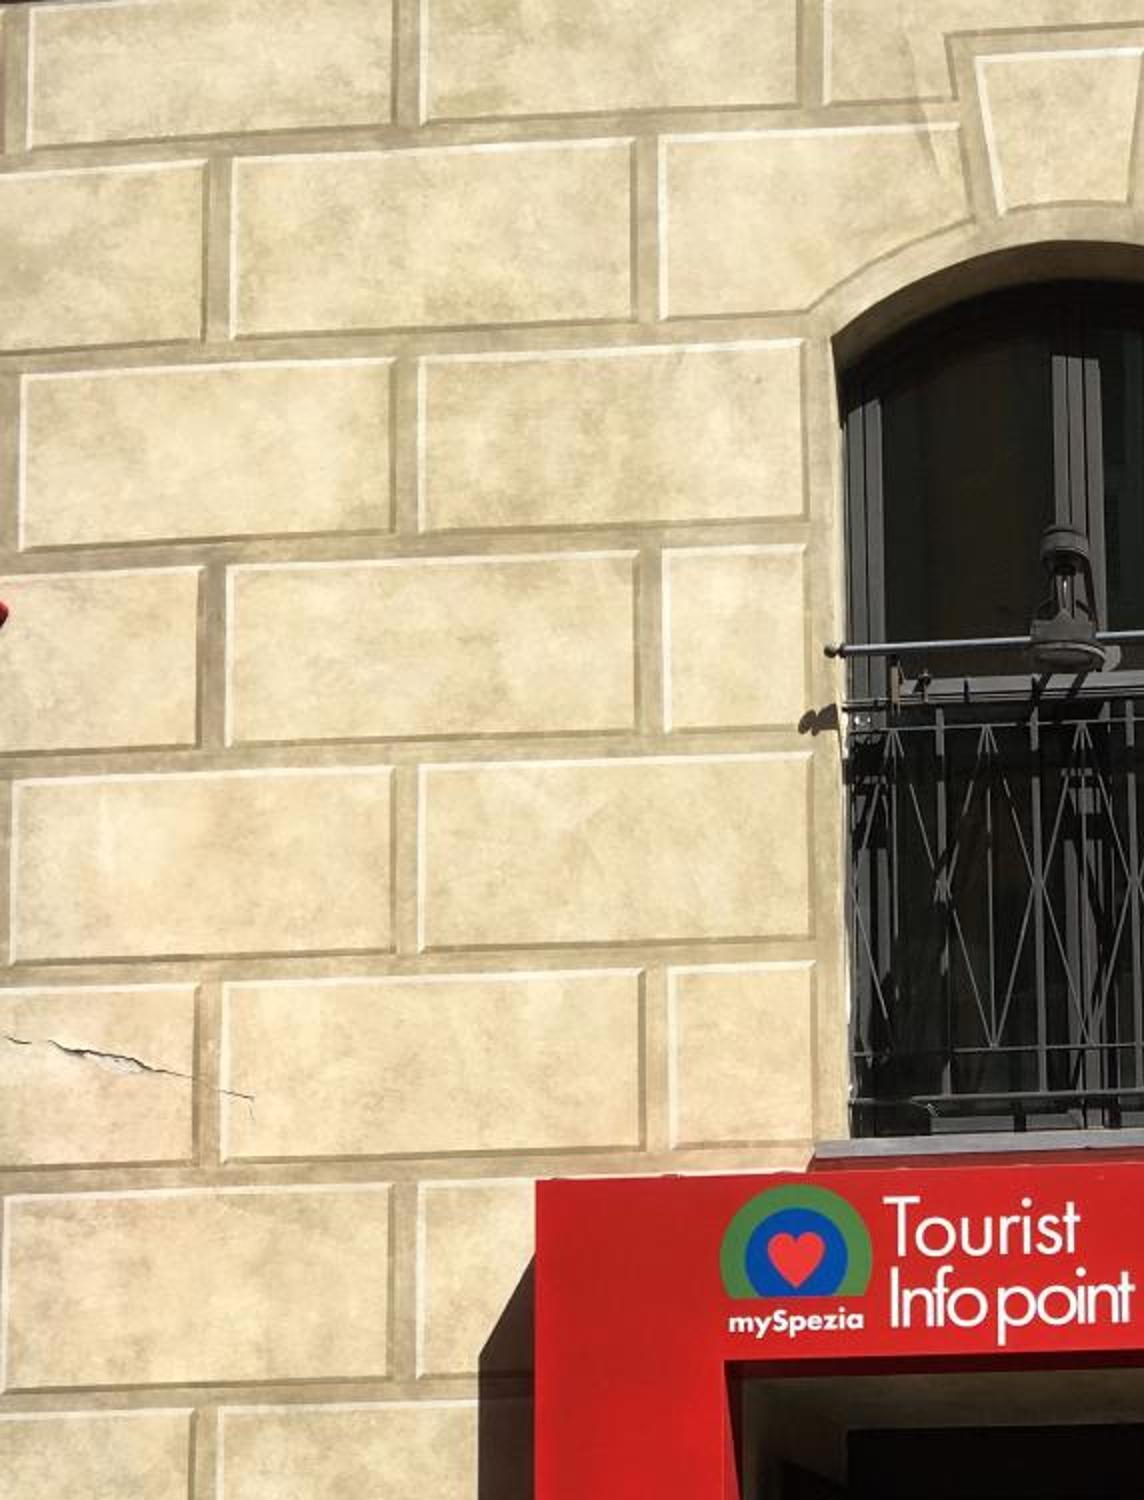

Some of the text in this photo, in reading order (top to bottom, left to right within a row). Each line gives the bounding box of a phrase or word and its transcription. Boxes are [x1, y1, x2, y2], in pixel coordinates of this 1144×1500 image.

[883, 1196, 1080, 1256] Tourist
[729, 1307, 864, 1338] mySpezia
[891, 1265, 1135, 1346] Info point
